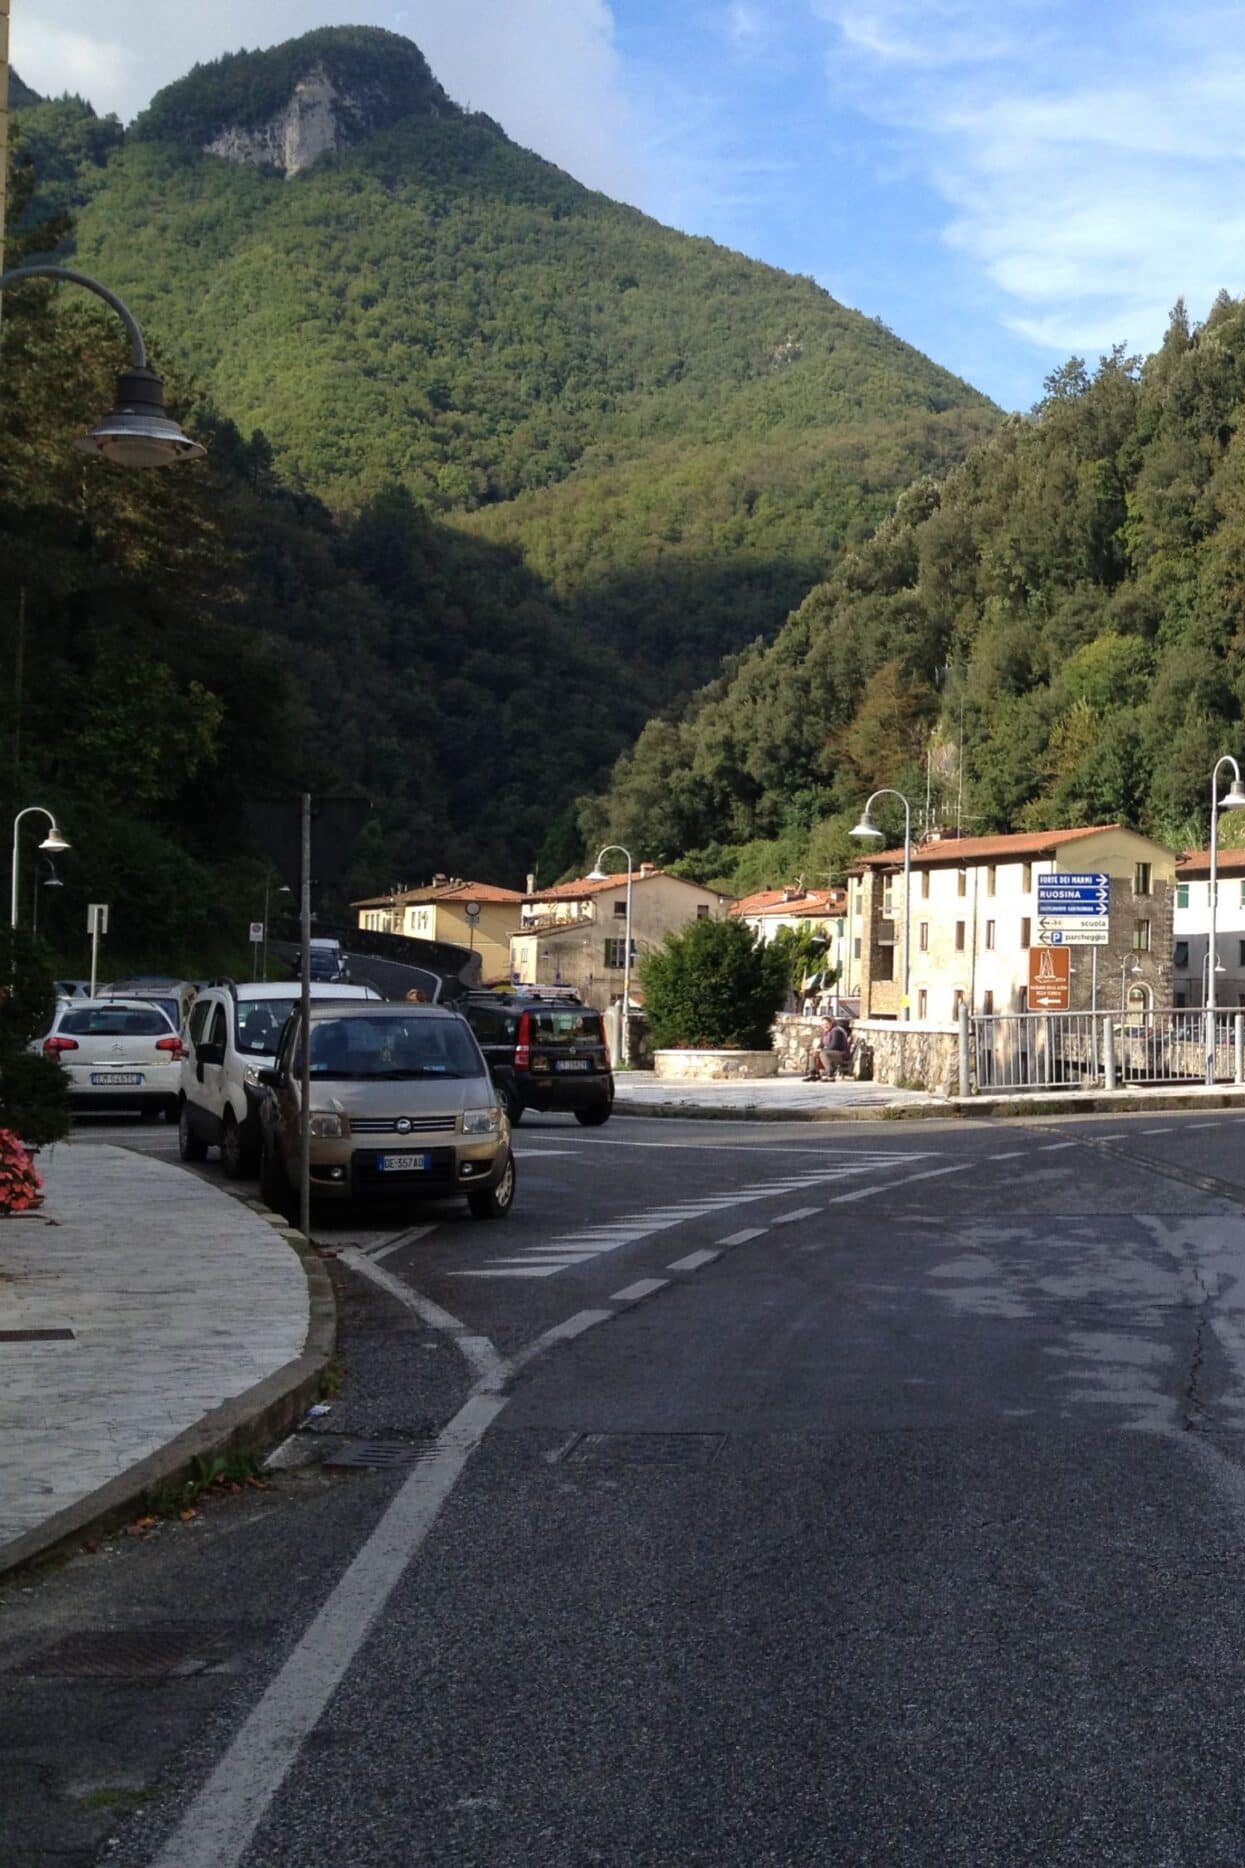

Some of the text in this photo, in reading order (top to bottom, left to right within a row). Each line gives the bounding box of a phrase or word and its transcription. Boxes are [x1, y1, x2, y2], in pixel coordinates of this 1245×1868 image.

[1040, 876, 1093, 884] FORTE DEI MARMI
[1040, 890, 1081, 899] RUOSINA
[1080, 919, 1106, 927] scuola
[1053, 933, 1106, 942] P parcheggio
